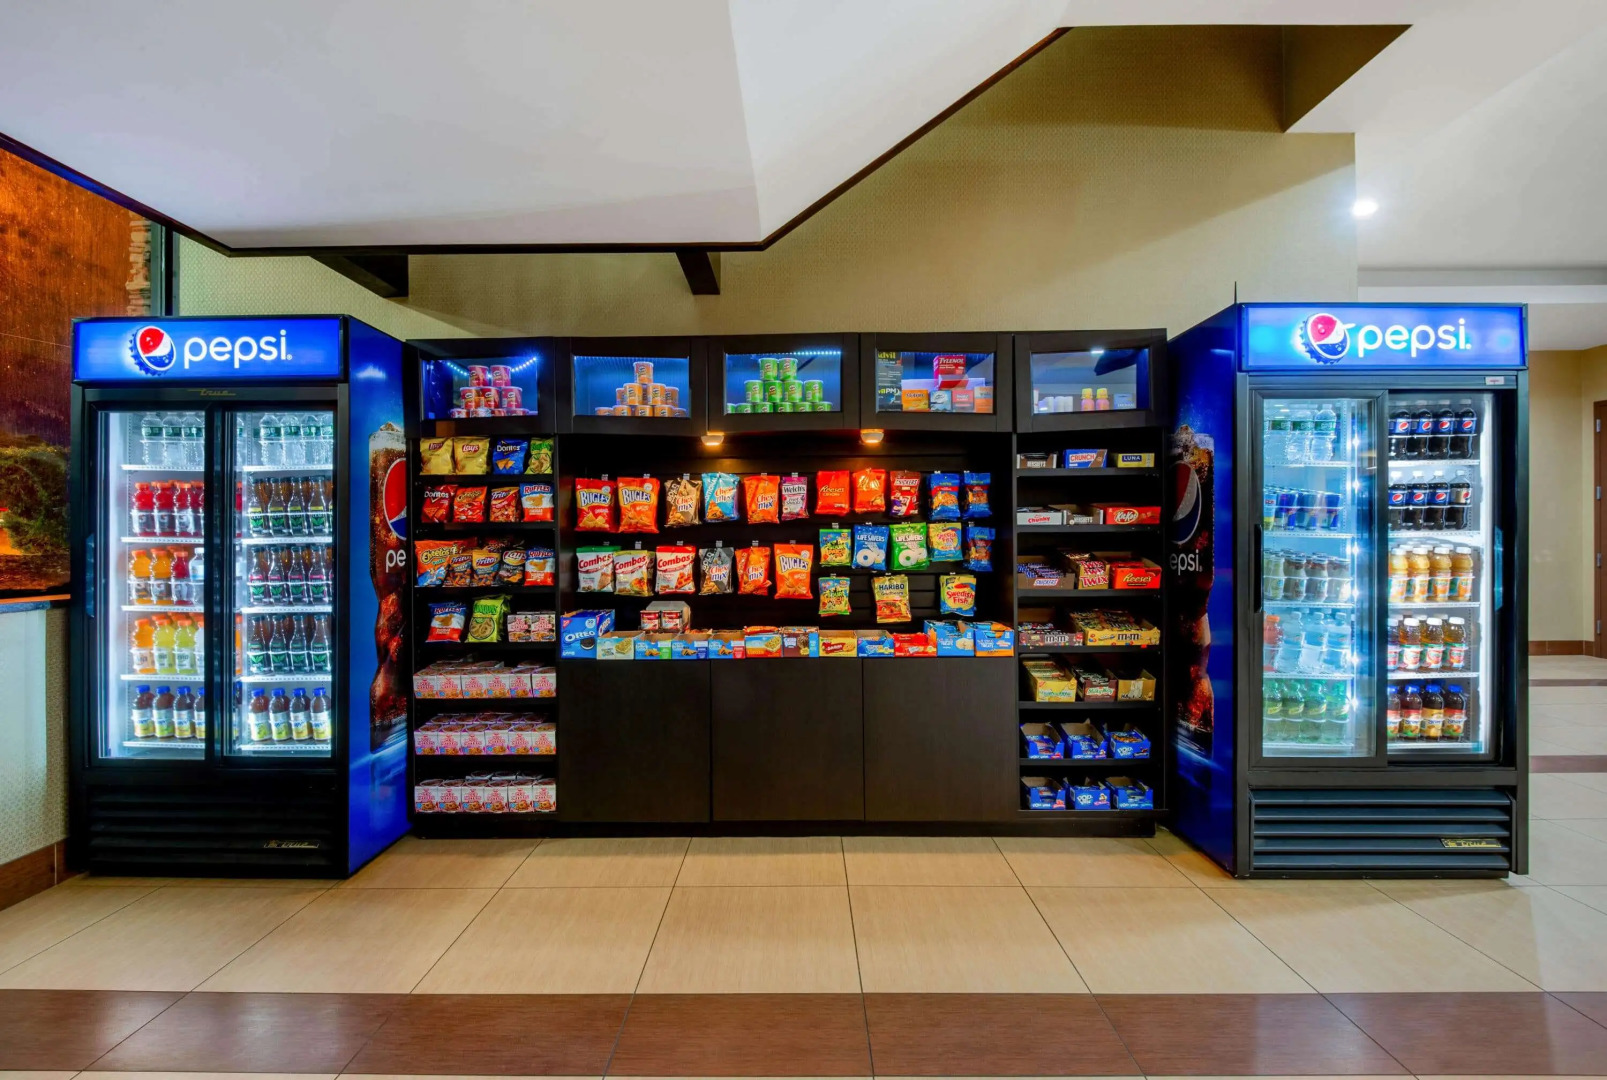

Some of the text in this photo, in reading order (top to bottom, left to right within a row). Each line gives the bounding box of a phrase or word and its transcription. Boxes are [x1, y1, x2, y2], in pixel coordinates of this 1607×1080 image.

[1358, 318, 1467, 358] pepsi
[184, 329, 287, 369] pepsi
[496, 444, 521, 452] Doritos
[1070, 453, 1096, 462] CRUNCH
[424, 490, 450, 499] Doritos
[524, 485, 551, 494] RUFFLES
[580, 490, 609, 507] BUGLES
[621, 488, 651, 505] BUGLES
[578, 553, 613, 569] Combos
[614, 555, 647, 571] Combos
[657, 554, 691, 569] Combos
[780, 555, 809, 573] BUGLES
[878, 583, 905, 591] HARIBO
[1080, 575, 1109, 587] TWIX
[946, 590, 975, 600] Swedish
[952, 597, 969, 605] Fish
[564, 630, 596, 642] OREO
